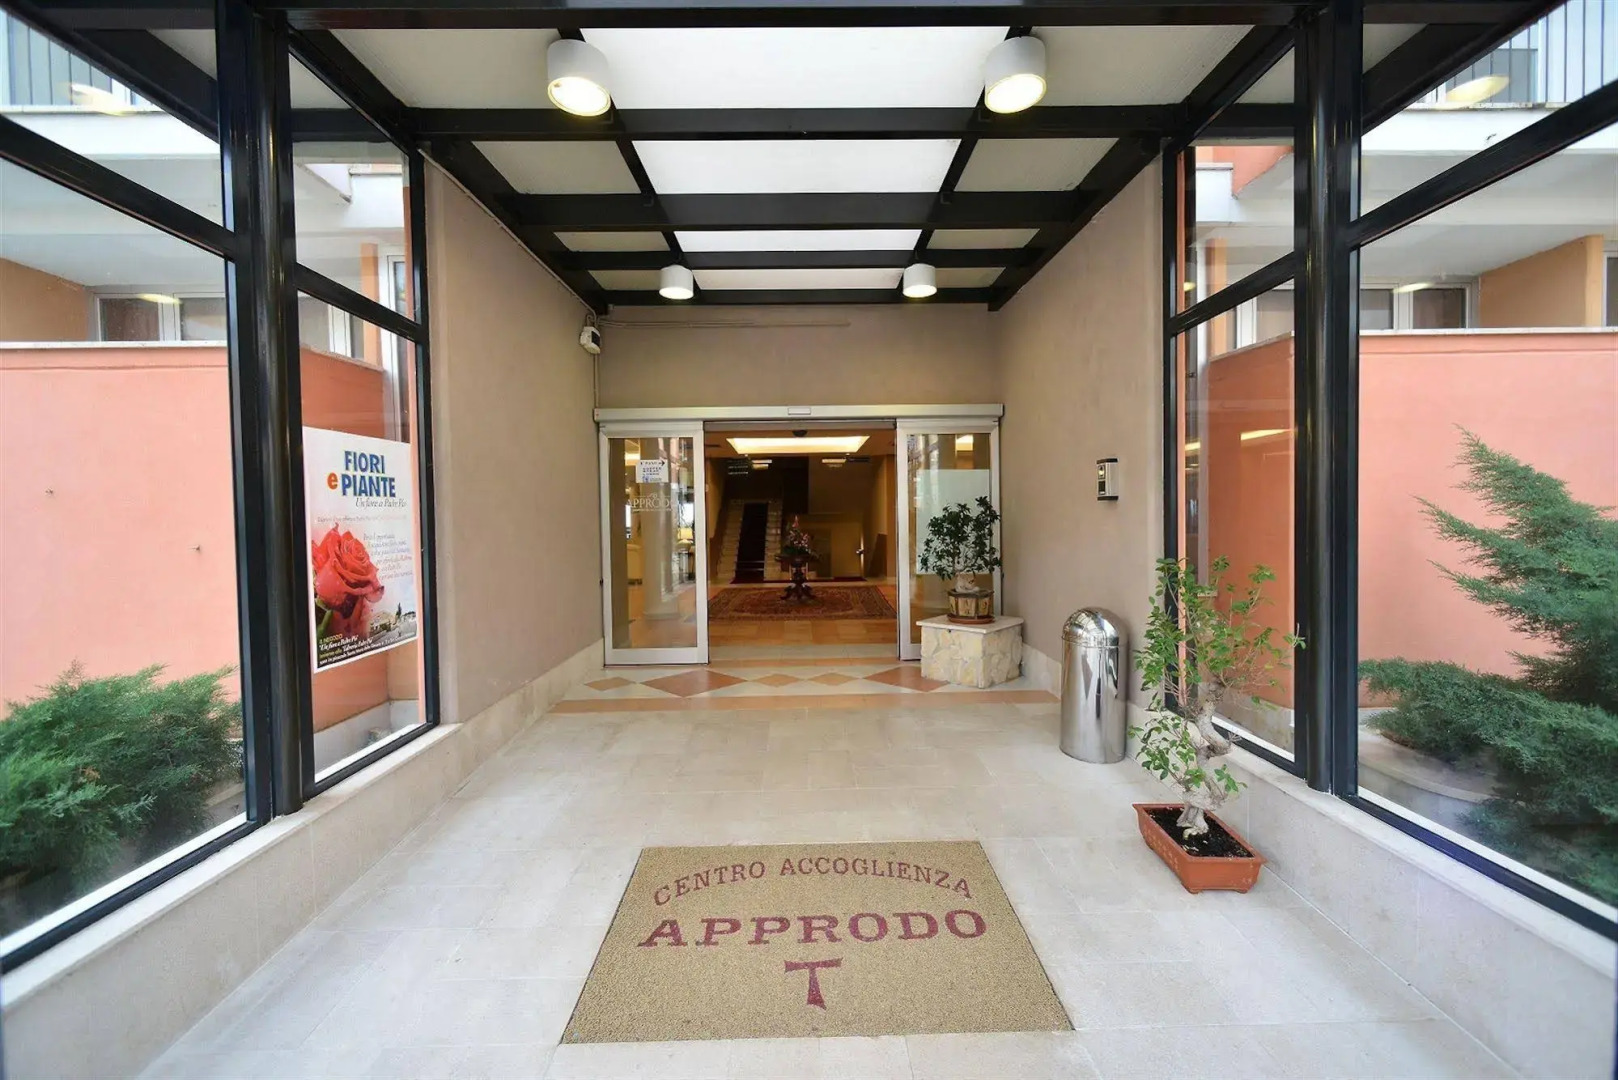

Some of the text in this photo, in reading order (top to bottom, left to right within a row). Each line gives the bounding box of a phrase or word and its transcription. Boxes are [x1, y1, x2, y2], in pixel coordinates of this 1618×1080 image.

[344, 450, 386, 474] FIORI
[327, 472, 396, 498] e PIANTE
[654, 857, 973, 906] CENTRO ACCOGLIENZA
[637, 909, 987, 947] APPRODO
